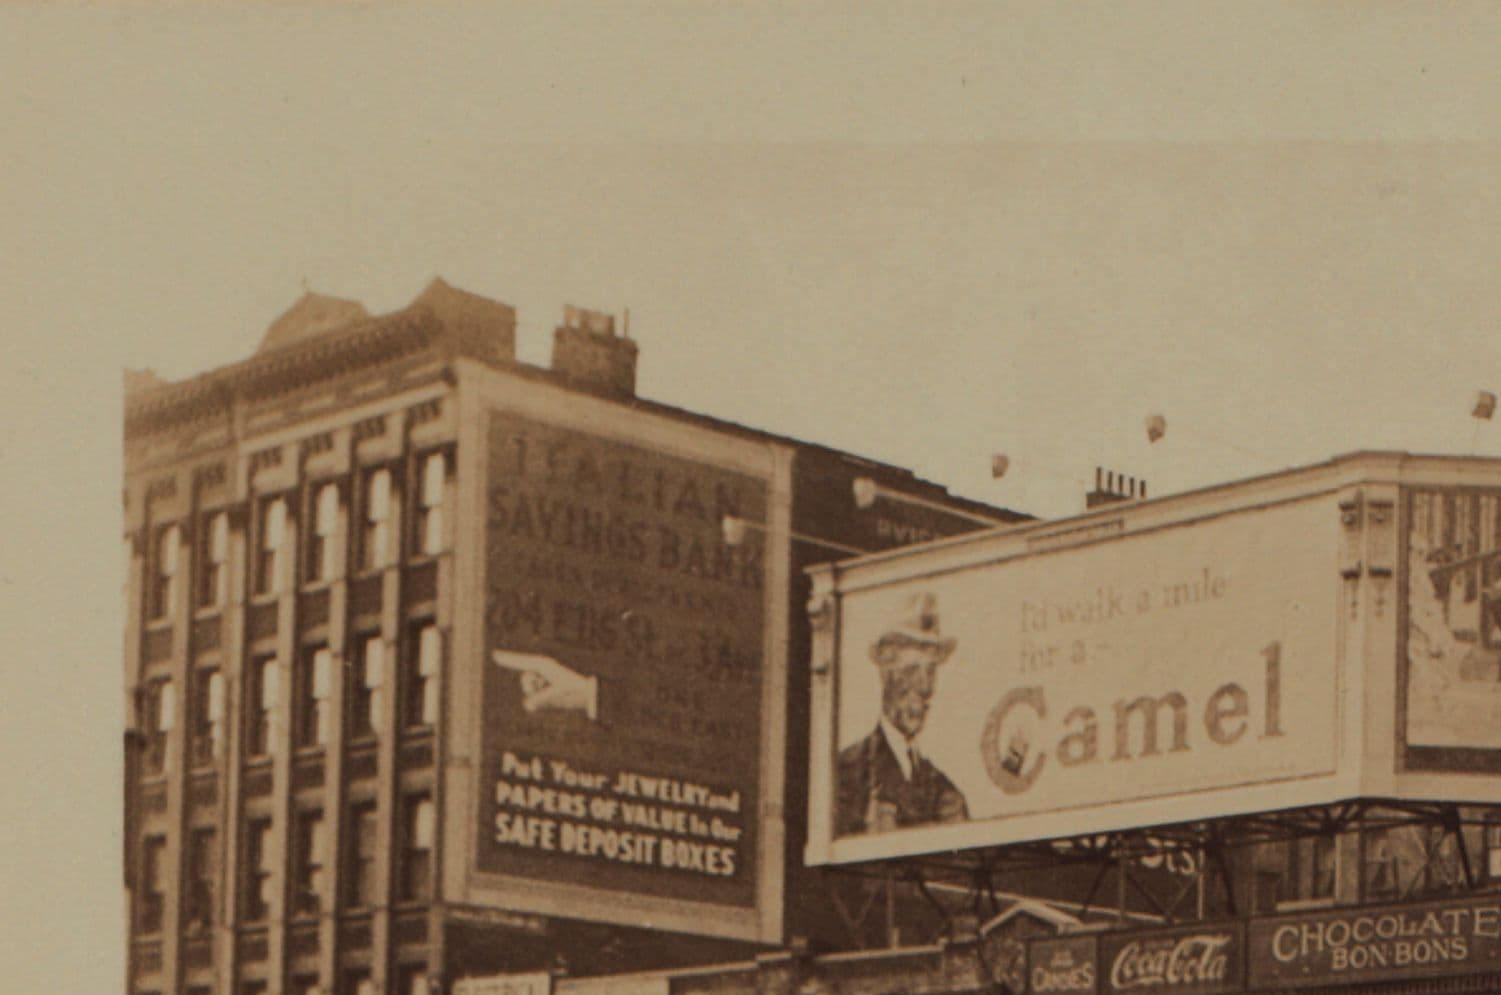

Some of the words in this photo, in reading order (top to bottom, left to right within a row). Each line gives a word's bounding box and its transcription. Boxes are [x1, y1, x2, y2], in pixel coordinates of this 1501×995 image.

[1162, 566, 1228, 606] mile
[979, 639, 1287, 796] Camel
[495, 780, 588, 819] PAPERS
[588, 797, 621, 822] OF
[621, 800, 689, 836] VALUE
[501, 752, 544, 782] Put
[549, 760, 611, 790] Your
[611, 770, 711, 808] JEWELRY
[495, 811, 557, 851] SAFE
[559, 820, 658, 864] DEPOSIT
[659, 836, 737, 877] BOXES
